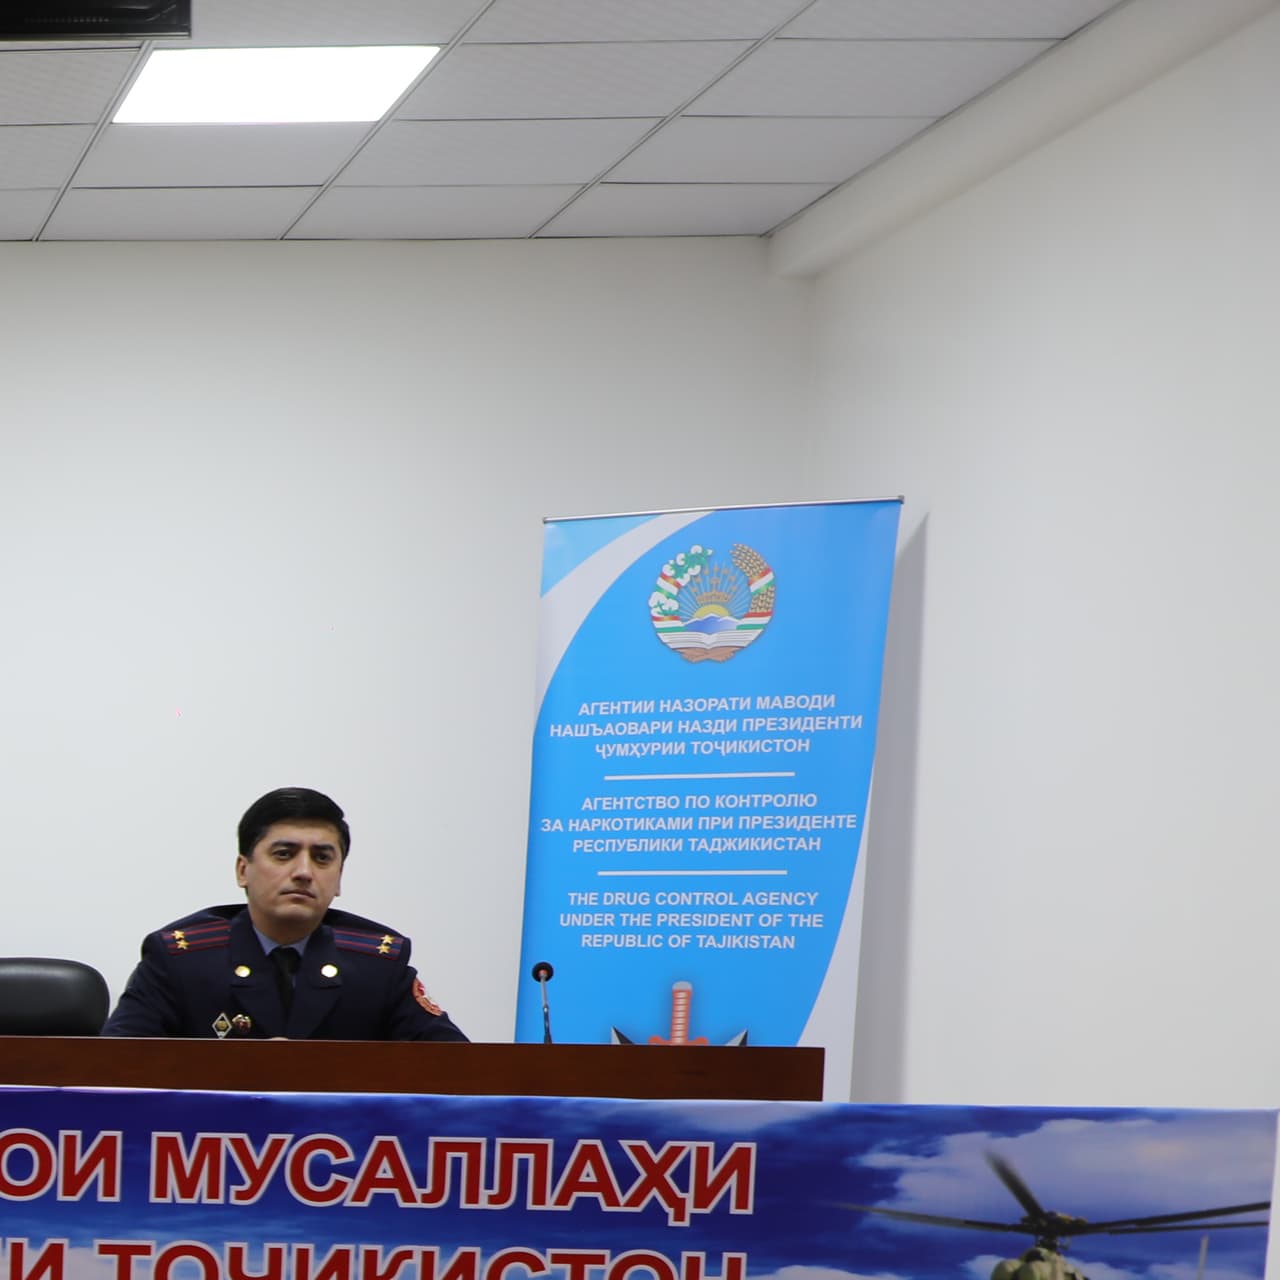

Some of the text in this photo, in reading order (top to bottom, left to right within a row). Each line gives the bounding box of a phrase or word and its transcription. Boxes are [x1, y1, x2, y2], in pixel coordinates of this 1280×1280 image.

[578, 694, 835, 716] АГЕНТИИ НАЗОРАТИ МАВОДИ
[550, 716, 863, 737] НАШЪАОВАРИ НАЗДИ ПРЕЗИДЕНТИ
[595, 739, 810, 759] ҶУМҲУРИИ ТОҶИКИСТОН
[581, 793, 817, 810] АГЕНТСТВО ПО КОНТРОЛЮ
[540, 814, 857, 832] ЗА НАРКОТИКАМИ ПРИ ПРЕЗИДЕНТЕ
[572, 837, 821, 854] РЕСПУБЛИКИ ТАДЖИКИСТАН
[568, 892, 819, 906] THE DRUG CONTROL AGENCY
[559, 913, 823, 928] UNDER THE PRESIDENT OF THE
[581, 934, 795, 948] REPUBLIC OF TAJIKISTAN
[148, 1131, 757, 1226] МУСАЛЛАҲИ
